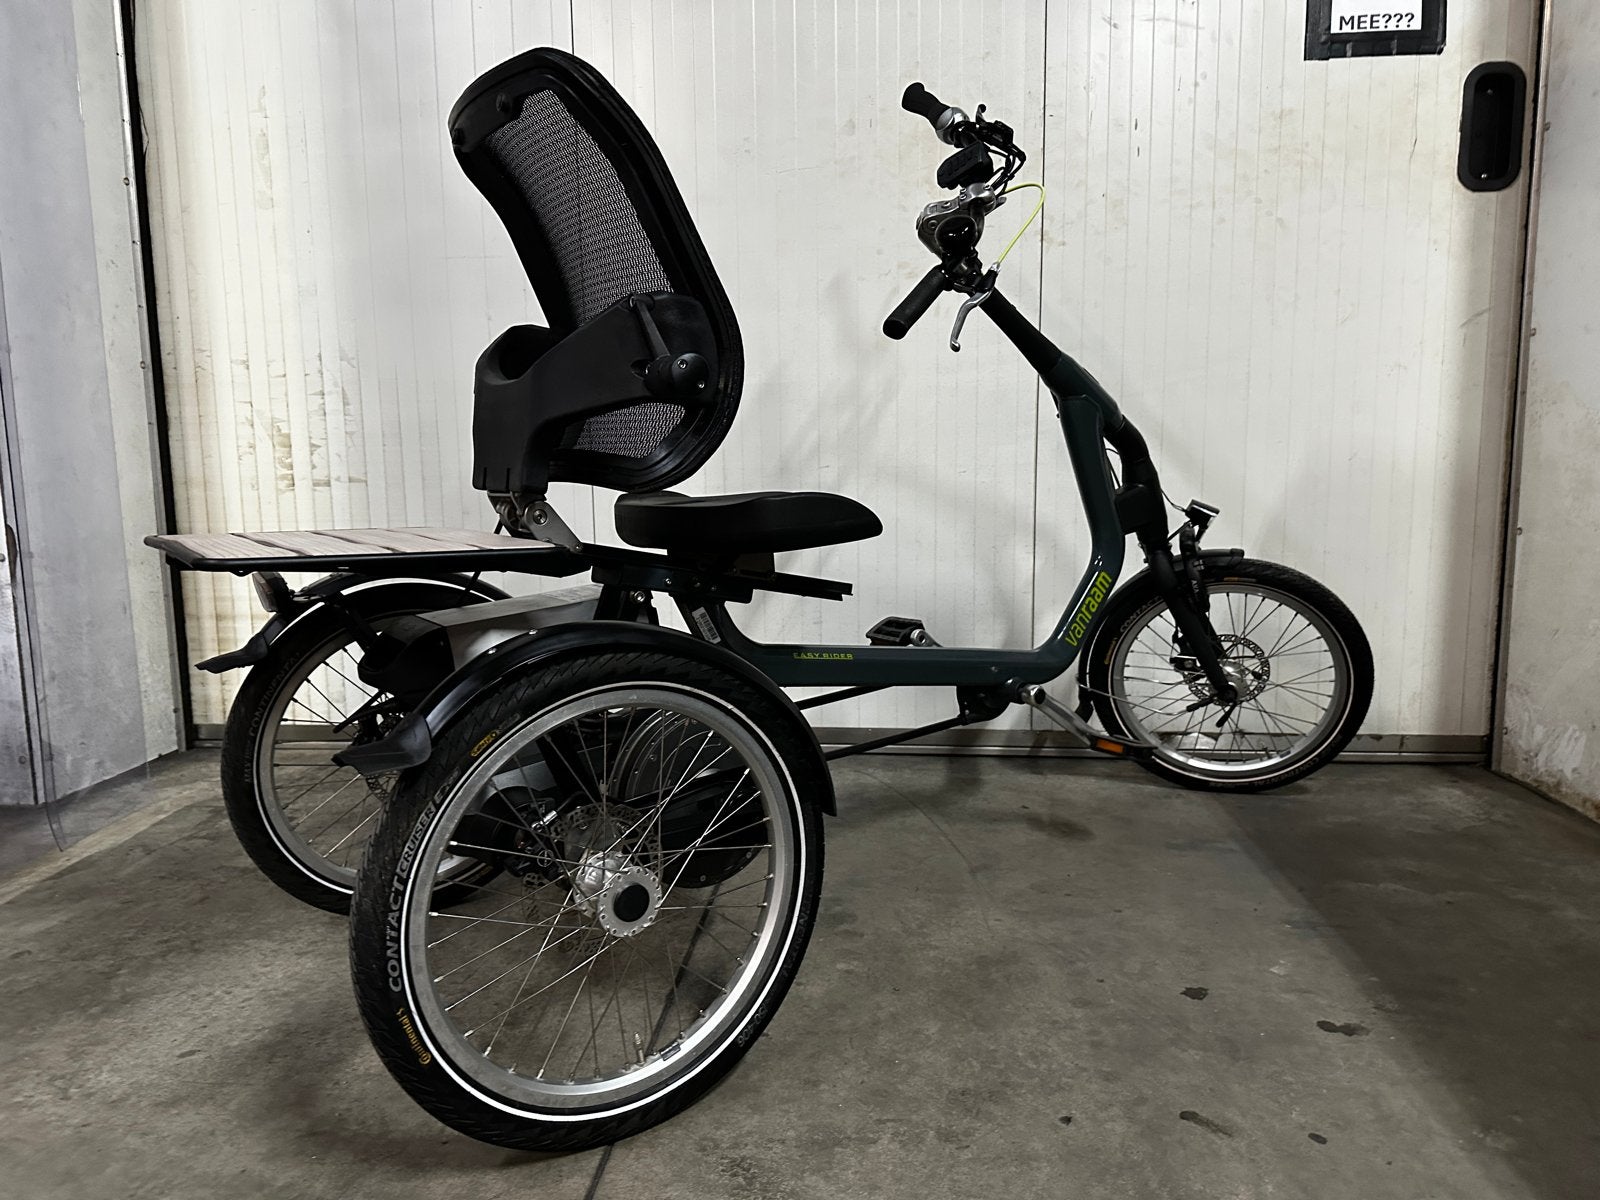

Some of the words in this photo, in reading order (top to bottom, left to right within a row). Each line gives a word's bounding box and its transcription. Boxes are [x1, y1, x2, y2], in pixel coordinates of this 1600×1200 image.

[1339, 12, 1415, 31] MEE???
[1064, 571, 1113, 647] vanraam
[793, 652, 820, 660] EASY
[822, 652, 854, 660] RIDER
[386, 874, 405, 993] CONTACT
[398, 803, 437, 877] CRUISER
[400, 1013, 432, 1066] Continental
